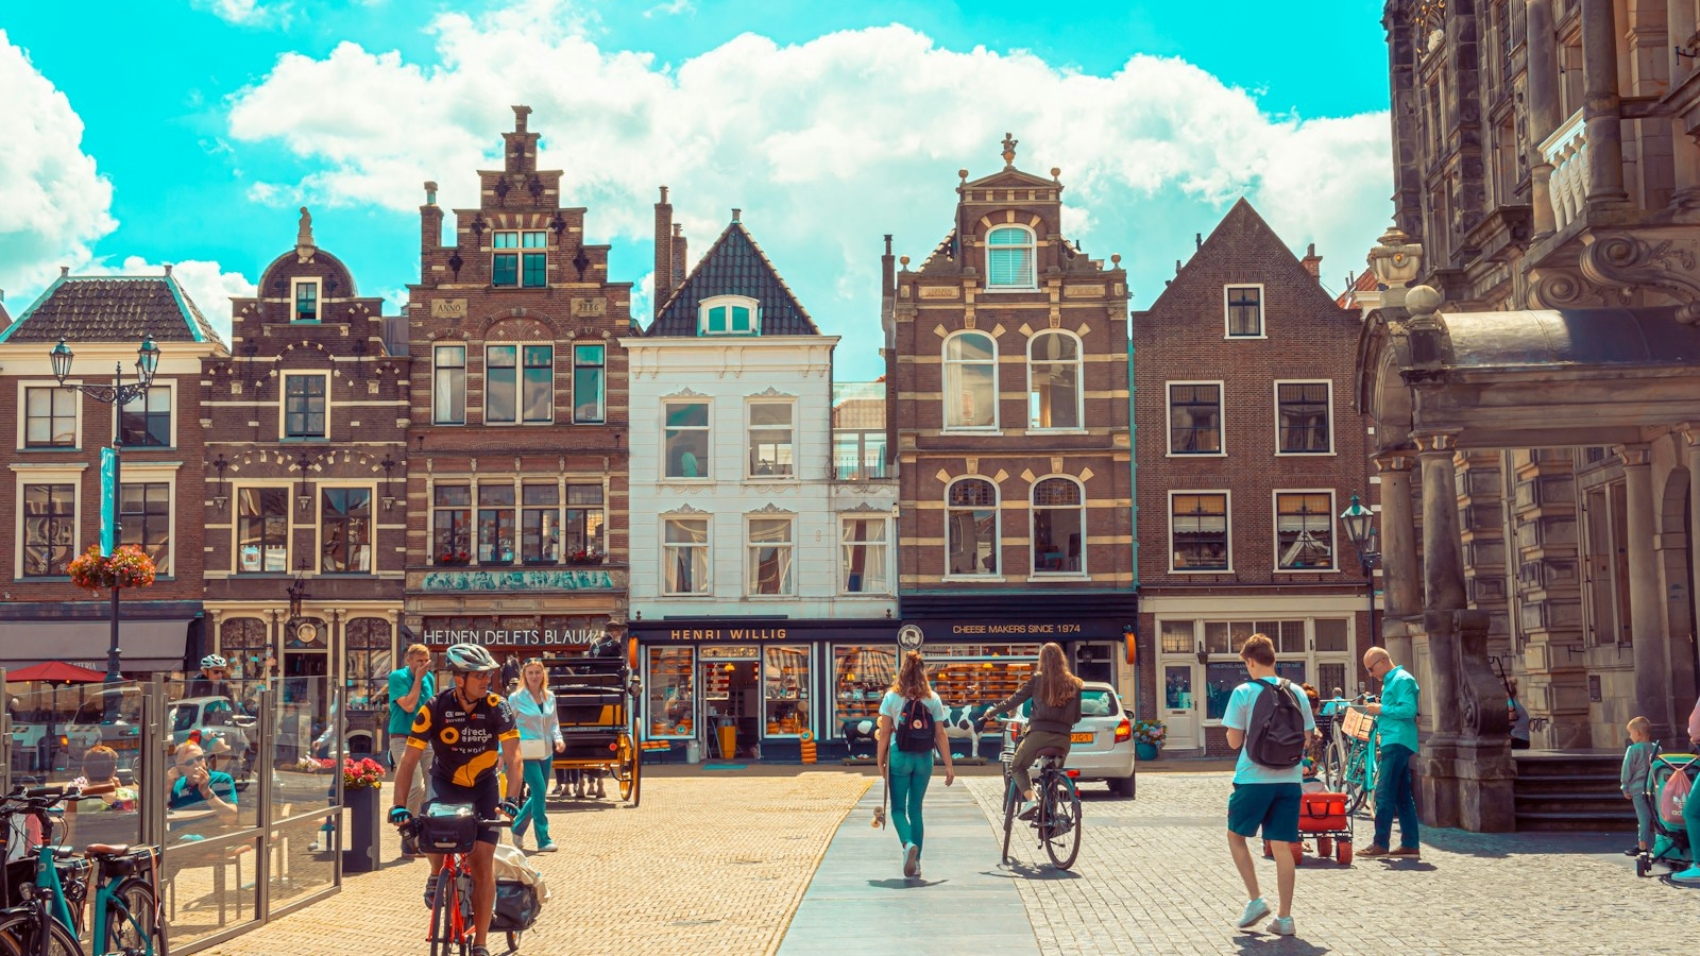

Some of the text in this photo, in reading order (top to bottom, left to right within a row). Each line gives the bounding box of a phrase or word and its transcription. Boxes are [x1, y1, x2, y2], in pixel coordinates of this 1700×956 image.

[438, 304, 461, 312] ANNO
[952, 624, 1081, 634] CHEESE MAKERS SINCE 1974
[424, 629, 599, 645] HEINEN DELFTS BLAUW
[671, 629, 787, 640] HENRI WILLIG
[461, 727, 487, 736] direct
